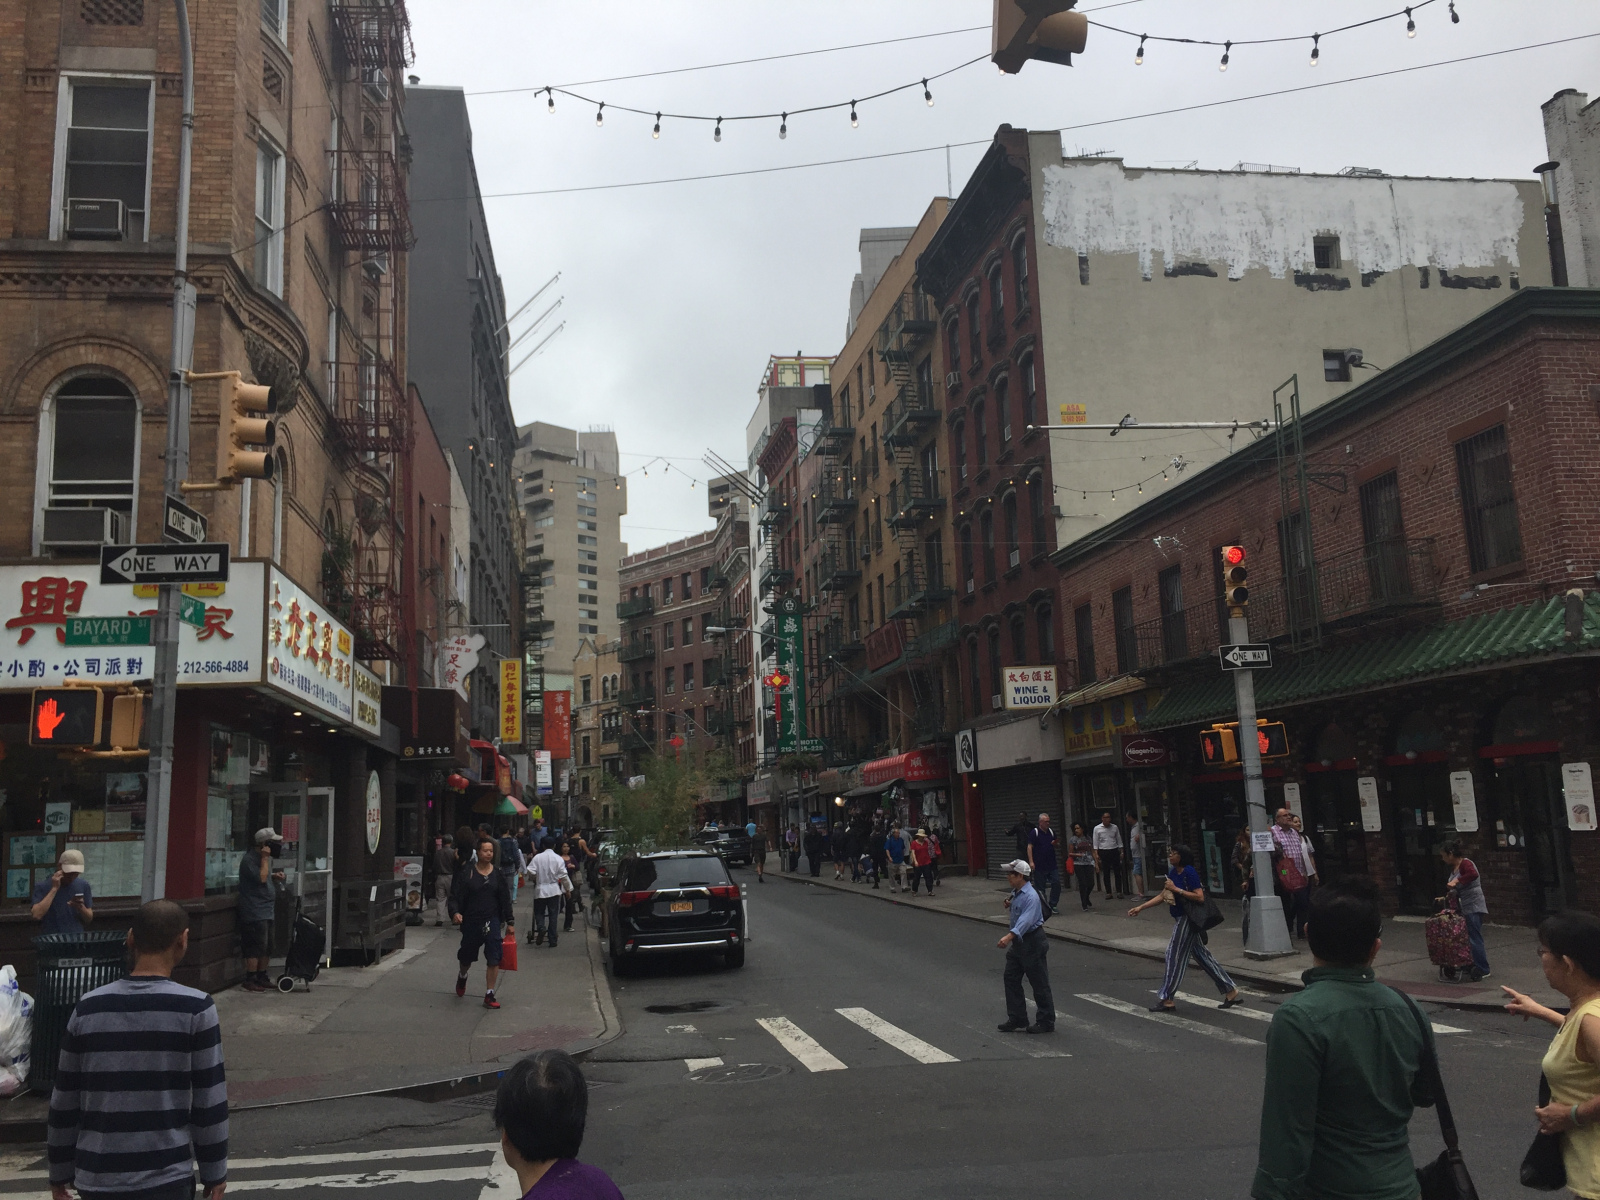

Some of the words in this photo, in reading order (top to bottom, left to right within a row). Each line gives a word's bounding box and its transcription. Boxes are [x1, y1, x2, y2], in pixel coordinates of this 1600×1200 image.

[172, 511, 186, 531] ONE
[190, 520, 203, 540] WAY
[121, 557, 156, 572] ONE
[175, 555, 212, 571] WAY
[73, 620, 131, 635] BAYARD
[138, 619, 147, 628] ST
[455, 637, 467, 646] 48
[1232, 652, 1248, 662] ONE
[1251, 651, 1265, 660] WAY
[183, 660, 249, 674] 212-566-4884
[1014, 686, 1039, 695] WINE
[1013, 695, 1051, 705] LIQUOR
